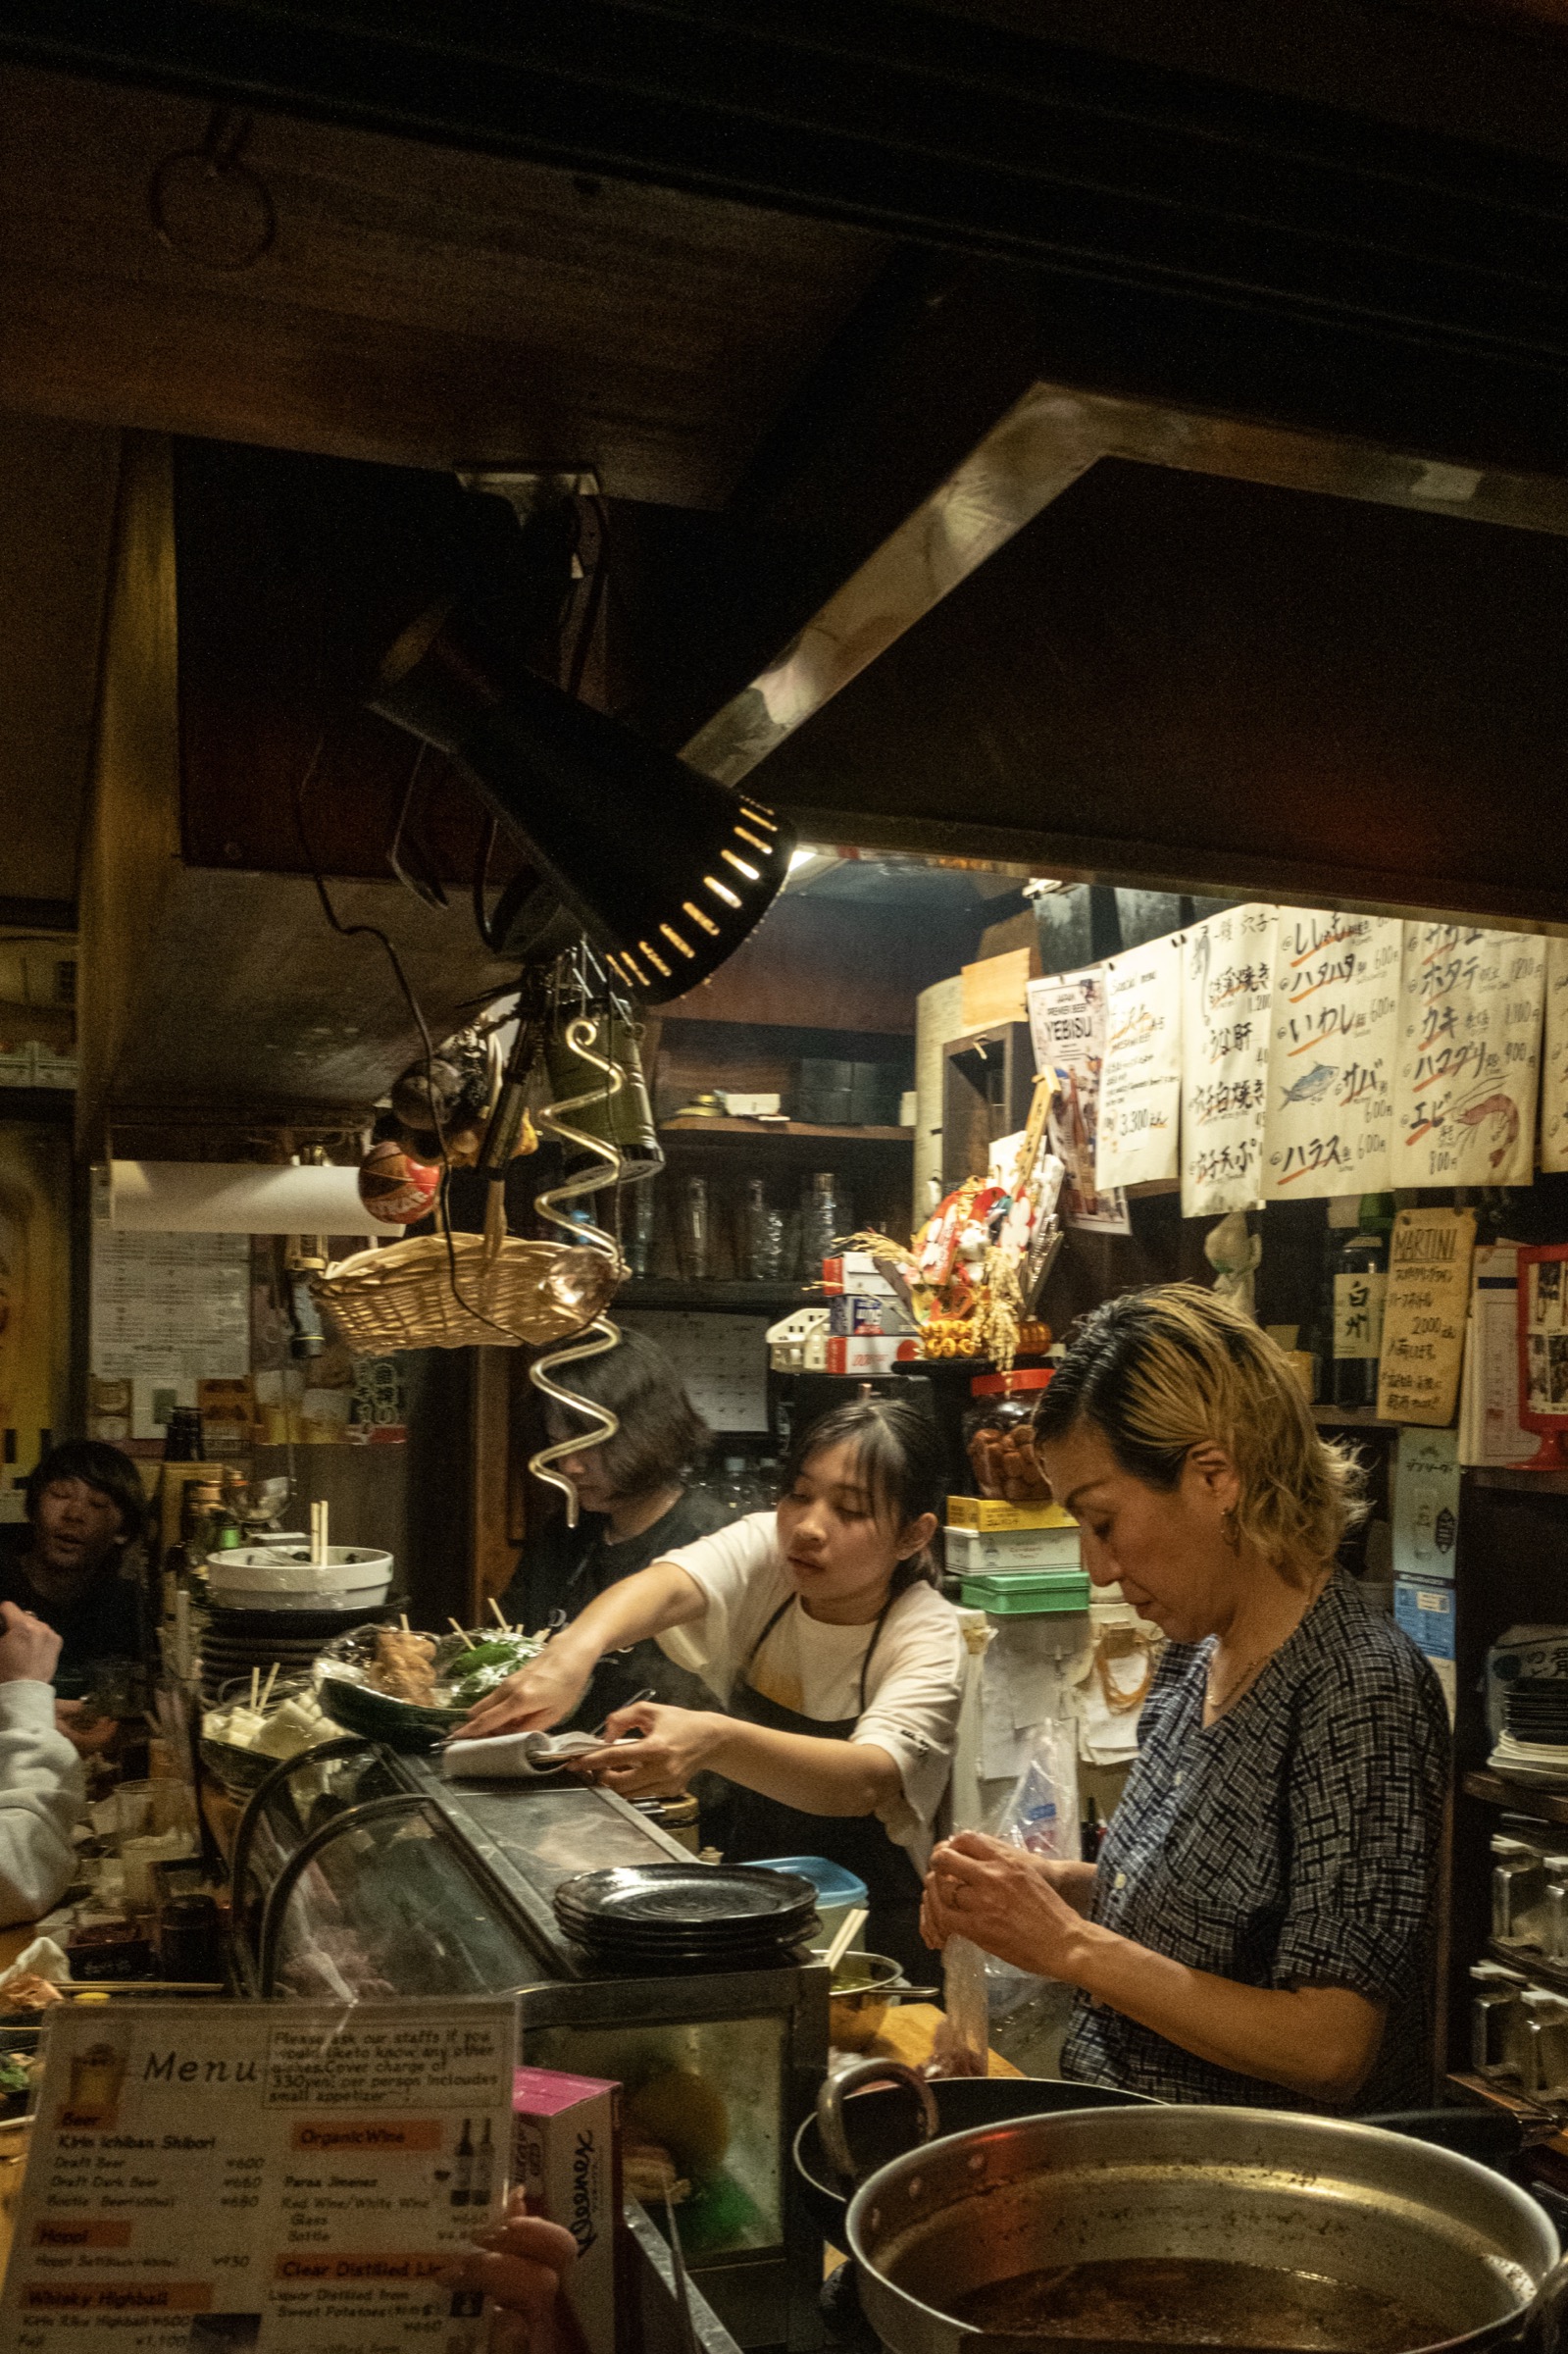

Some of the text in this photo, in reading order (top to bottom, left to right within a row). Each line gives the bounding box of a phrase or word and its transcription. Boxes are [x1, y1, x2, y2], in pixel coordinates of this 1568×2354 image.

[1043, 1015, 1091, 1042] YEBISU
[1288, 1002, 1357, 1043] いわし
[1283, 1134, 1342, 1172] ハラス
[1395, 1228, 1458, 1258] MARTINI
[1344, 1280, 1371, 1343] 白州
[331, 2034, 357, 2045] ask
[363, 2034, 388, 2045] our
[394, 2029, 441, 2044] staffs
[447, 2028, 460, 2042] if
[465, 2031, 492, 2049] you
[422, 2047, 448, 2066] any
[454, 2045, 496, 2058] other
[142, 2050, 259, 2082] Menu
[375, 2059, 426, 2073] charge
[431, 2060, 448, 2072] of
[340, 2076, 367, 2090] per
[371, 2076, 422, 2090] person
[269, 2089, 311, 2103] small
[63, 2111, 102, 2126] Beer
[59, 2135, 95, 2149] Kirin
[162, 2134, 217, 2150] Shibori
[55, 2156, 92, 2169] Draft
[96, 2157, 127, 2169] Beer
[51, 2175, 88, 2188] Draft
[93, 2175, 125, 2188] Dark
[129, 2175, 160, 2187] Beer
[569, 2128, 599, 2260] Kleenex
[280, 2197, 310, 2210] Red
[398, 2197, 430, 2209] Wine
[290, 2212, 329, 2226] Glass
[40, 2227, 90, 2245] Hoppi
[287, 2229, 331, 2243] Bottle
[282, 2260, 331, 2277] Clear
[335, 2260, 411, 2277] Distilled
[28, 2289, 169, 2310] Whisky Highball
[317, 2287, 375, 2302] Distilled
[379, 2287, 411, 2301] from
[277, 2305, 321, 2319] Sweet
[23, 2315, 56, 2328] Kirin
